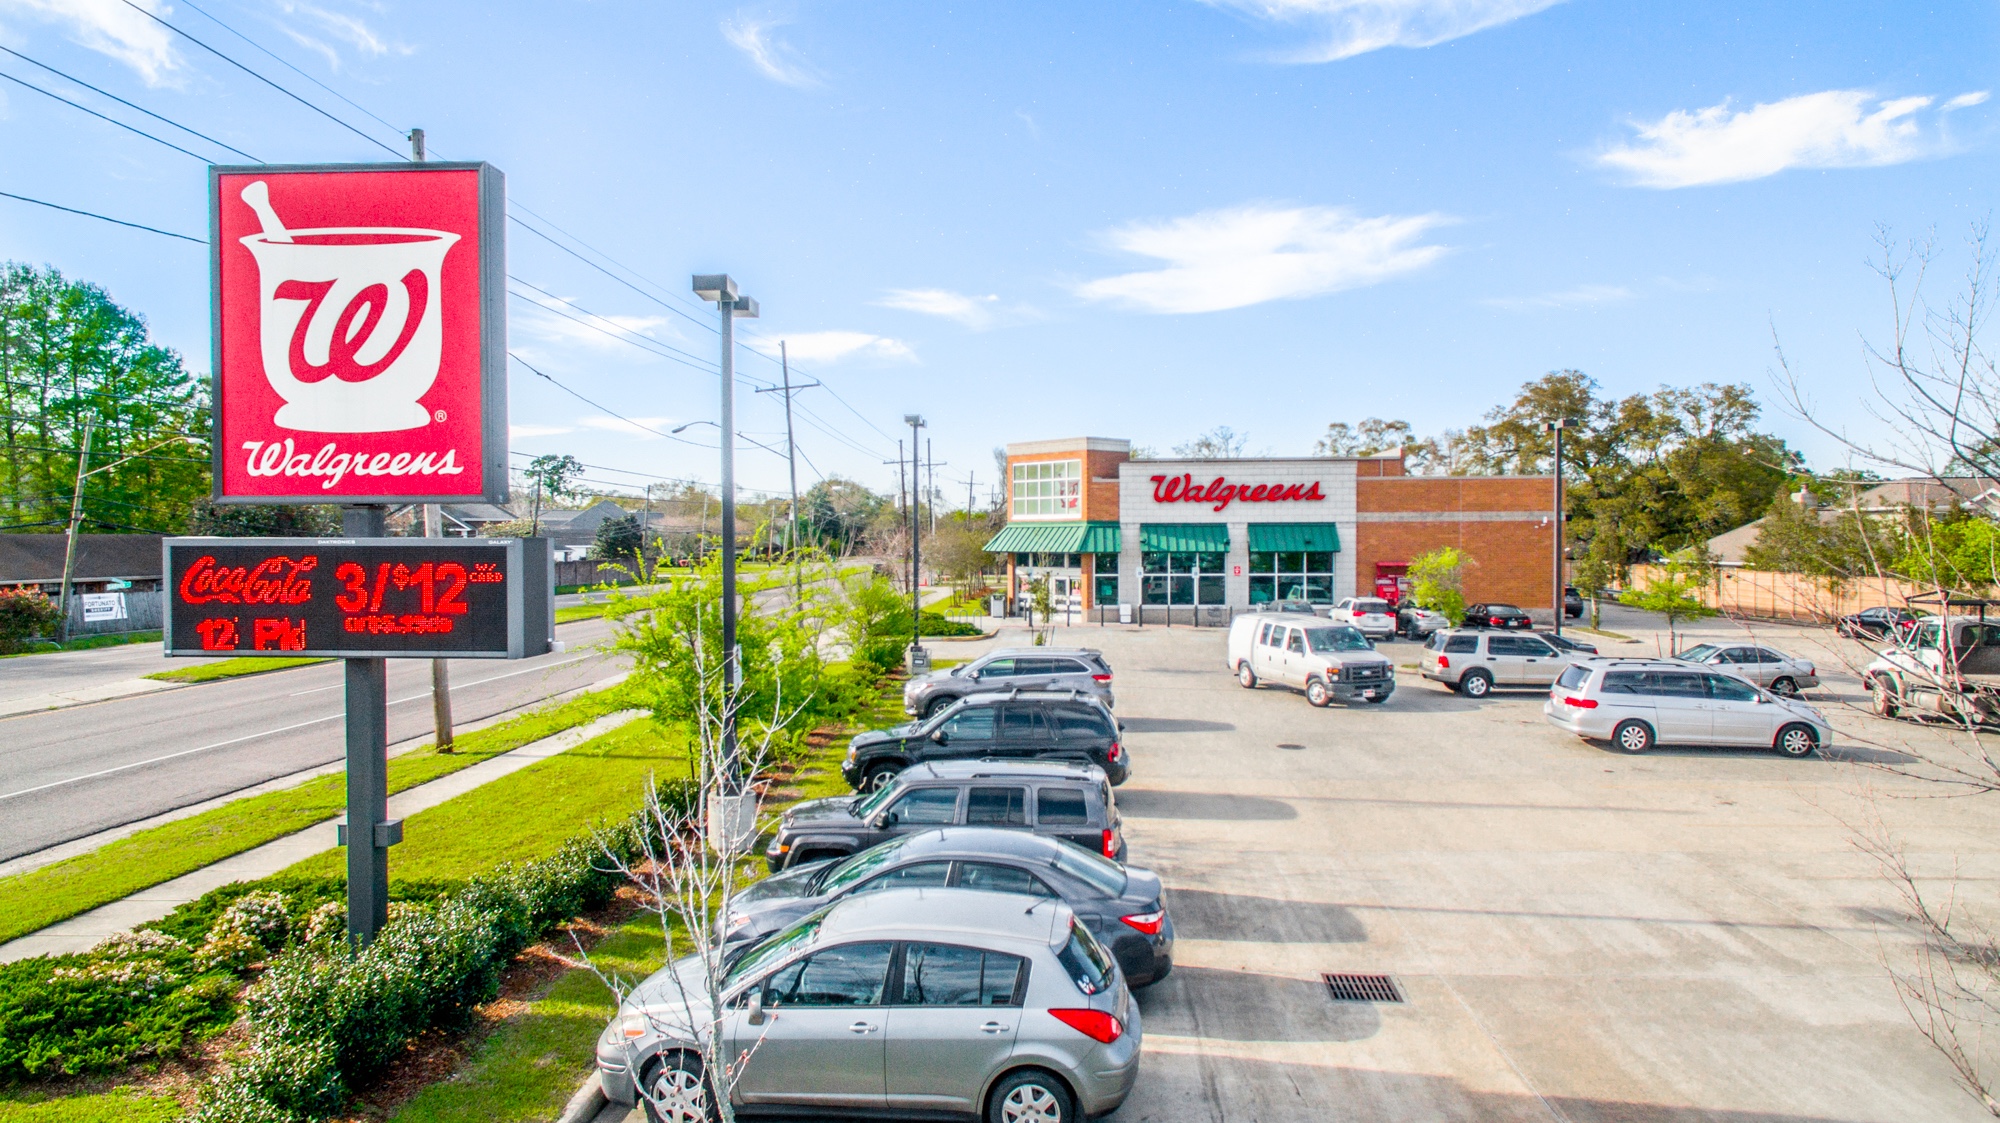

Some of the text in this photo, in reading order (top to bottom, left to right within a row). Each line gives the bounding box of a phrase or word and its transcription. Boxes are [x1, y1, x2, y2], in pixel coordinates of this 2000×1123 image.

[273, 268, 429, 384] W
[242, 438, 464, 489] Walgreens
[1150, 473, 1326, 512] Walgreens
[468, 572, 504, 582] CARD
